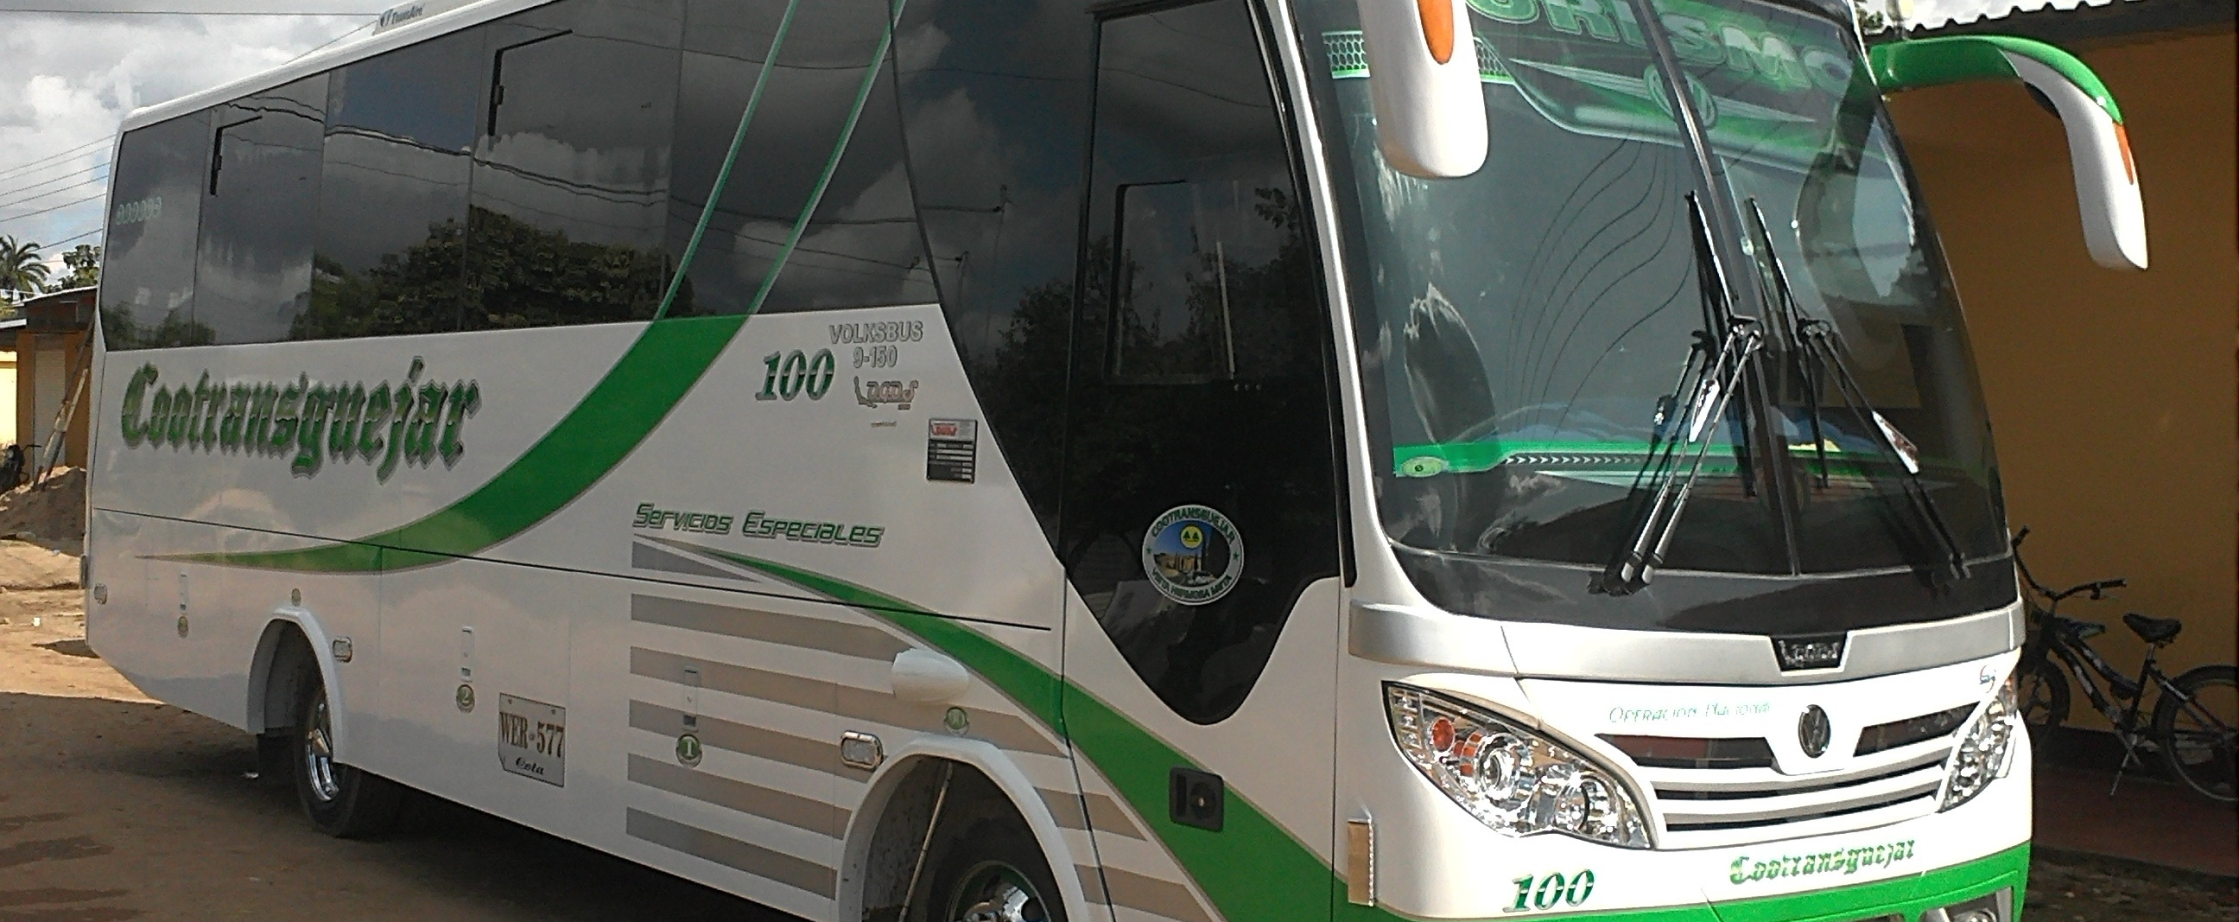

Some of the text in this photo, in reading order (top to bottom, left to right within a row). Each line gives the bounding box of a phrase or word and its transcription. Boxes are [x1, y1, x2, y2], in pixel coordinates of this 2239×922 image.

[829, 321, 924, 344] VOLKSBUS
[853, 345, 898, 368] 9-150
[756, 348, 836, 401] 100
[121, 355, 482, 485] Cootransguejar
[516, 757, 545, 775] Cola
[1503, 869, 1596, 912] 100
